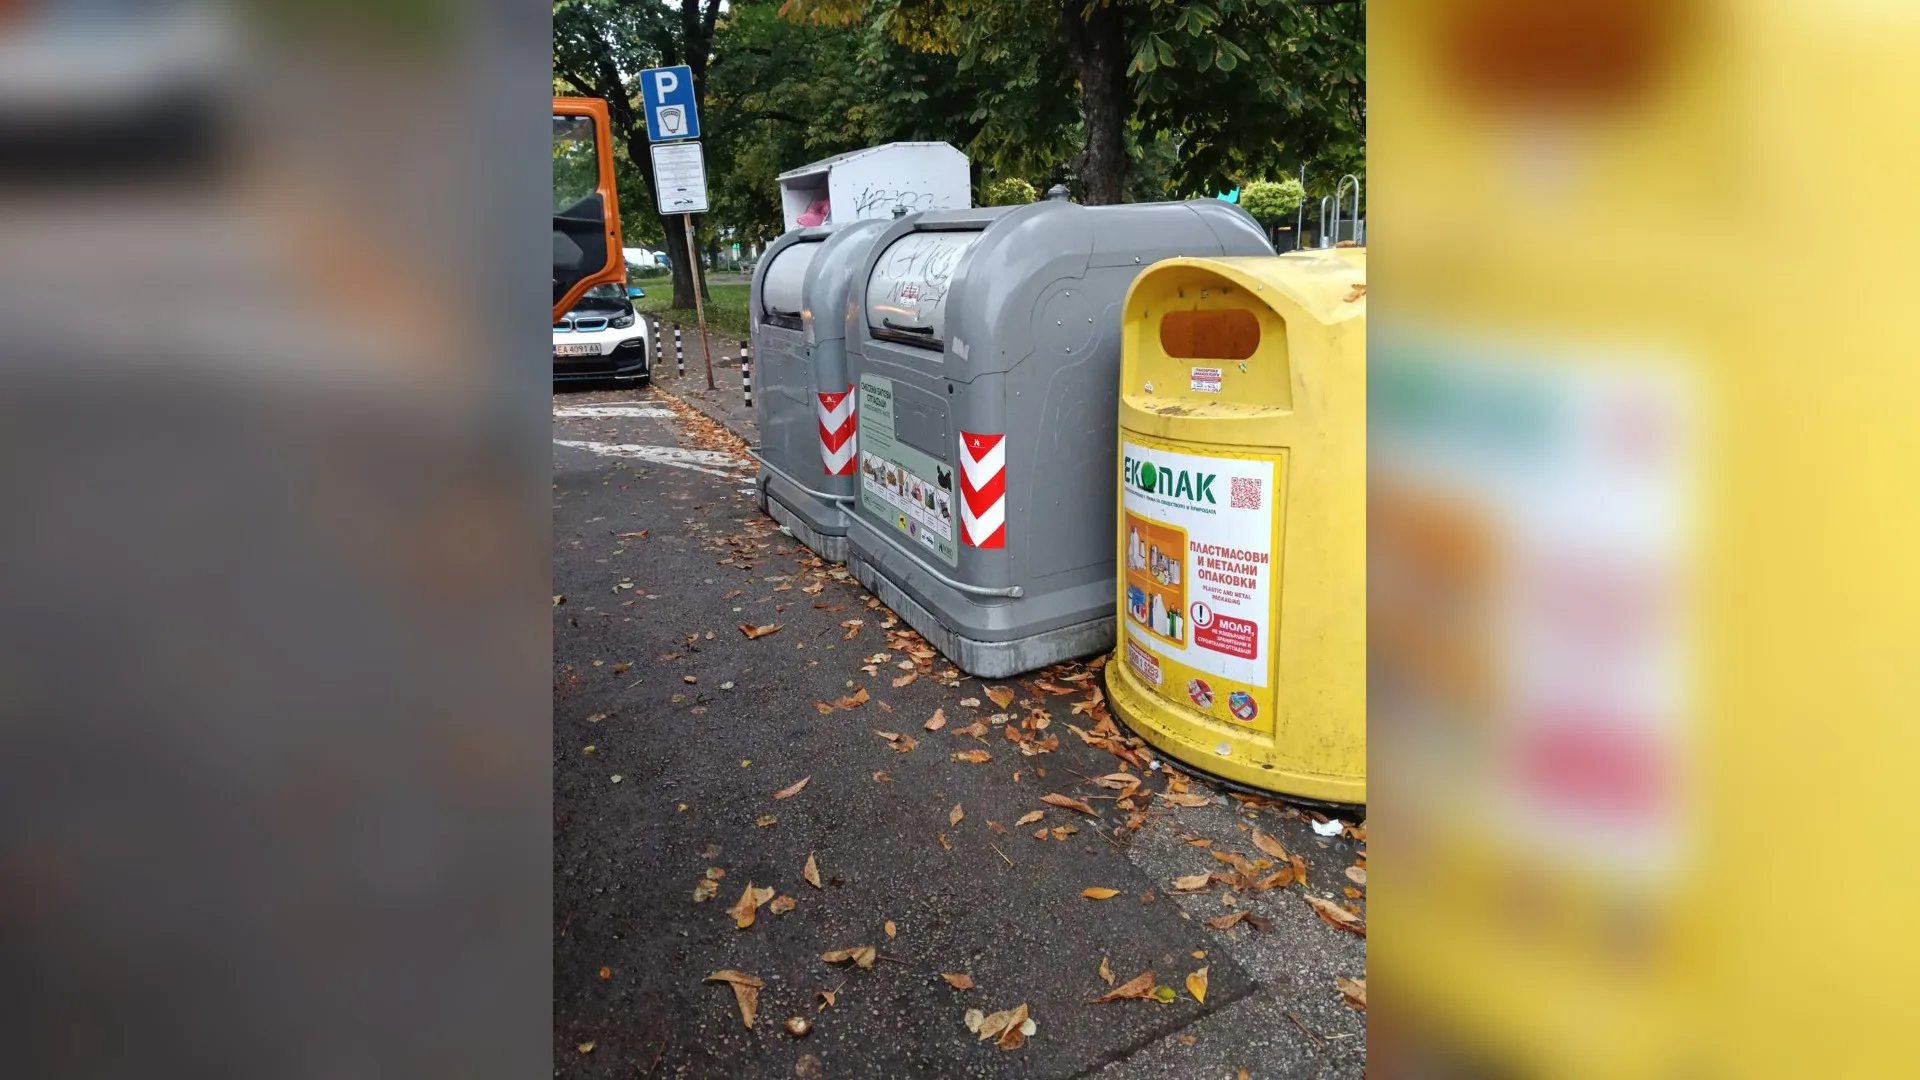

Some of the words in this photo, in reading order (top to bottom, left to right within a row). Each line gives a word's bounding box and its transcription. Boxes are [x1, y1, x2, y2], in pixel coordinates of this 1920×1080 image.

[655, 71, 678, 104] P
[569, 345, 588, 353] 4091
[1124, 456, 1217, 504] ЕКОПАК
[1190, 541, 1269, 564] ПЛАСТМАСОВИ
[1197, 556, 1204, 566] И
[1207, 557, 1258, 576] МЕТАЛНИ
[1198, 569, 1257, 590] ОПАКОВКИ
[1202, 585, 1222, 594] PLASTIC
[1223, 589, 1233, 597] AND
[1234, 591, 1252, 600] METAL
[1212, 594, 1241, 605] PACKAGING
[1219, 619, 1255, 637] МОЛЯ,
